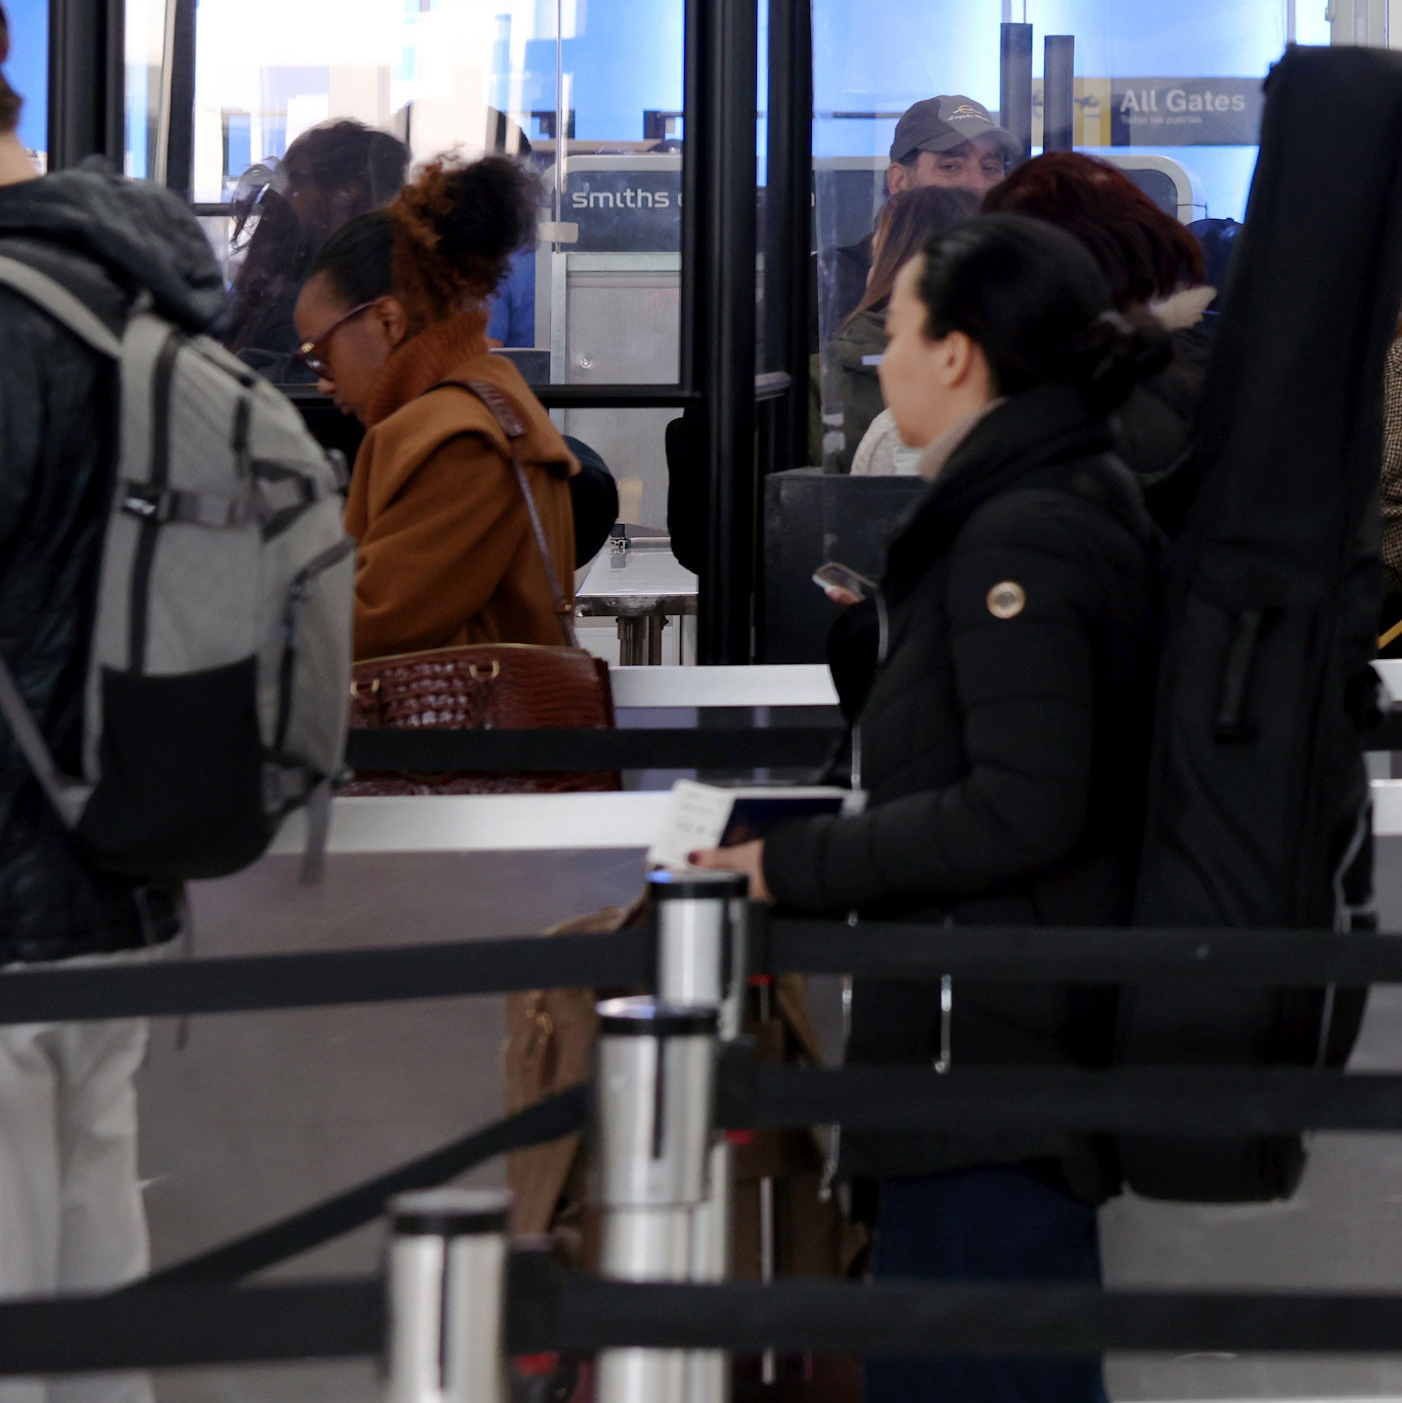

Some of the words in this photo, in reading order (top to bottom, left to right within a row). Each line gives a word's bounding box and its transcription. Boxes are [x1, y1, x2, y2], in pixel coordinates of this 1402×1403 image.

[1120, 89, 1159, 113] All
[1166, 89, 1246, 113] Gates
[571, 188, 670, 209] smiths
